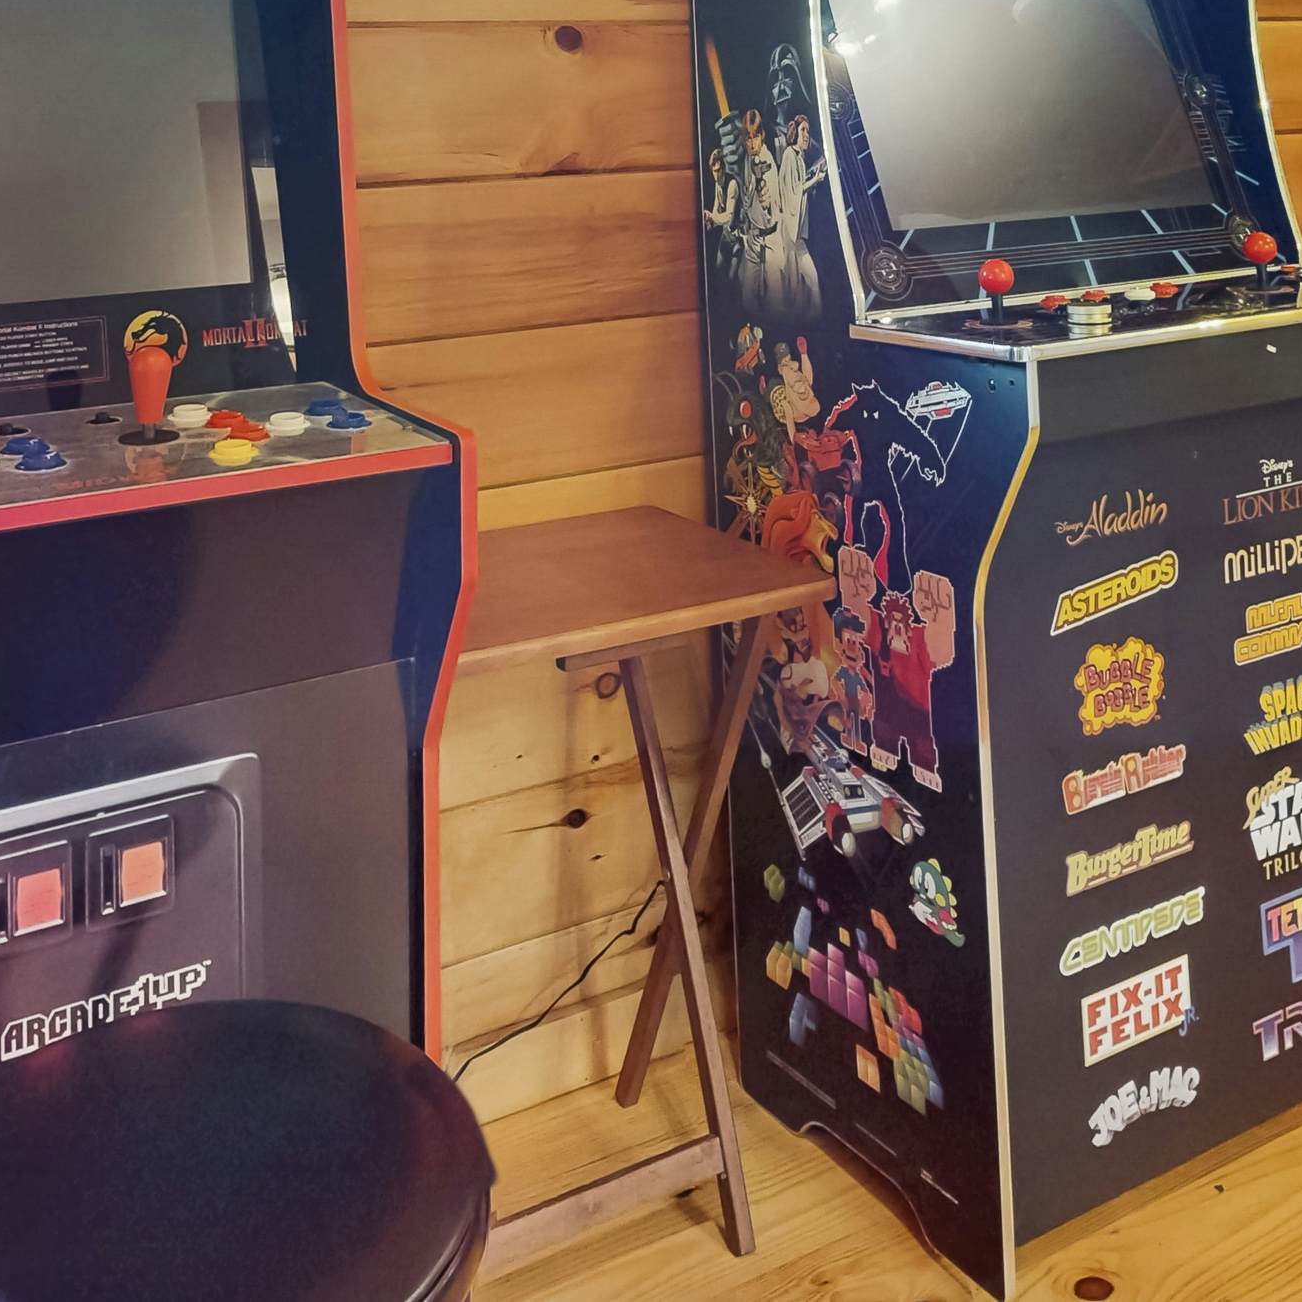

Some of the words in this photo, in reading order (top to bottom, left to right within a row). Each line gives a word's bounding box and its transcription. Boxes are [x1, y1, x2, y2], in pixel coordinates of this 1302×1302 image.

[202, 325, 255, 347] MORTAL
[257, 319, 307, 342] KOAT
[1222, 491, 1275, 525] LION
[1263, 472, 1292, 487] THE
[1066, 489, 1168, 546] Aladdin
[1052, 551, 1177, 635] ASTEROIDS
[1084, 652, 1154, 693] BUBBLE
[1094, 682, 1151, 717] BOBBLE
[1059, 886, 1205, 976] CENTIPEDE
[1087, 964, 1183, 1029] FIX-IT
[1089, 992, 1184, 1057] FELIX
[1088, 1079, 1142, 1147] JOE
[1149, 1065, 1200, 1110] MAC
